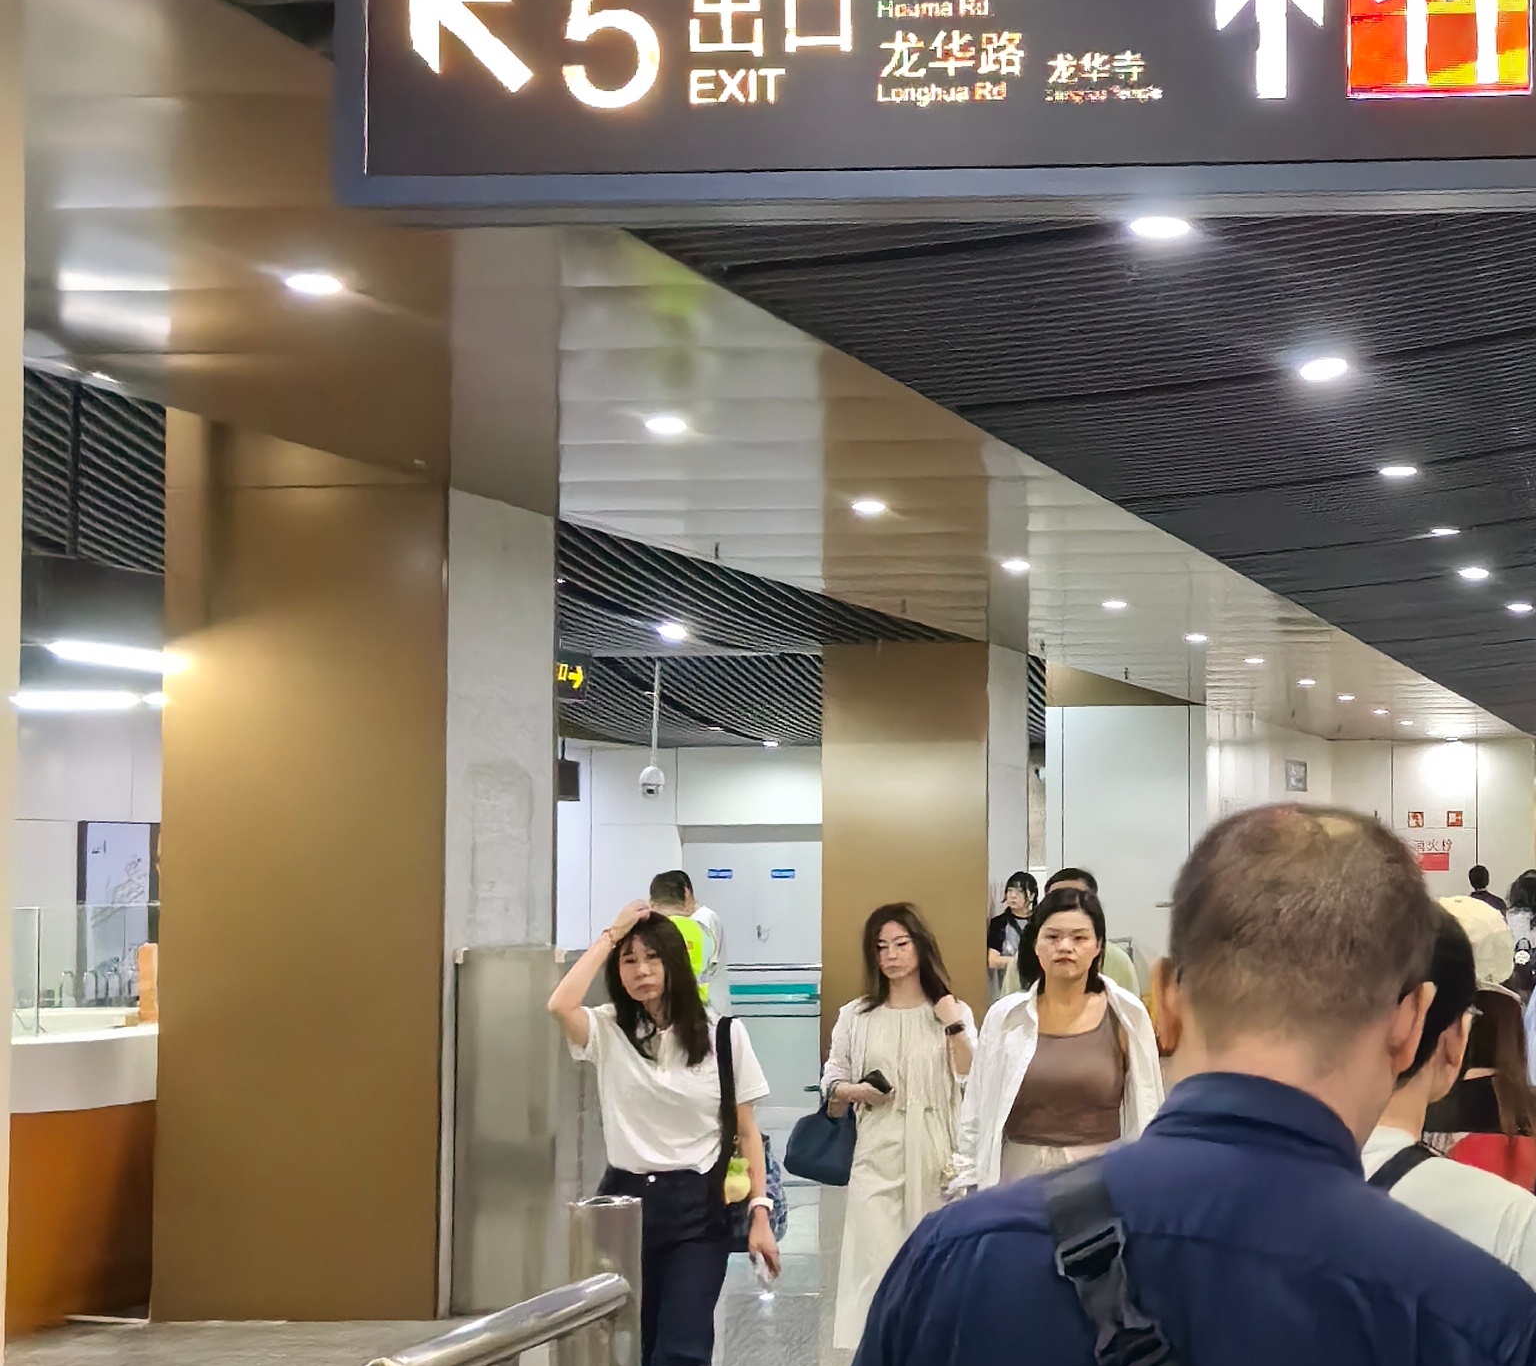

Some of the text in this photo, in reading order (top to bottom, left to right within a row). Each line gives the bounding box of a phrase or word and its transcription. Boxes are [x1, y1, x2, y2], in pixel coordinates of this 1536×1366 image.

[879, 29, 1025, 78] 龙华路
[1047, 50, 1146, 84] 龙华寺
[689, 67, 786, 105] EXIT
[876, 82, 970, 108] Longhua
